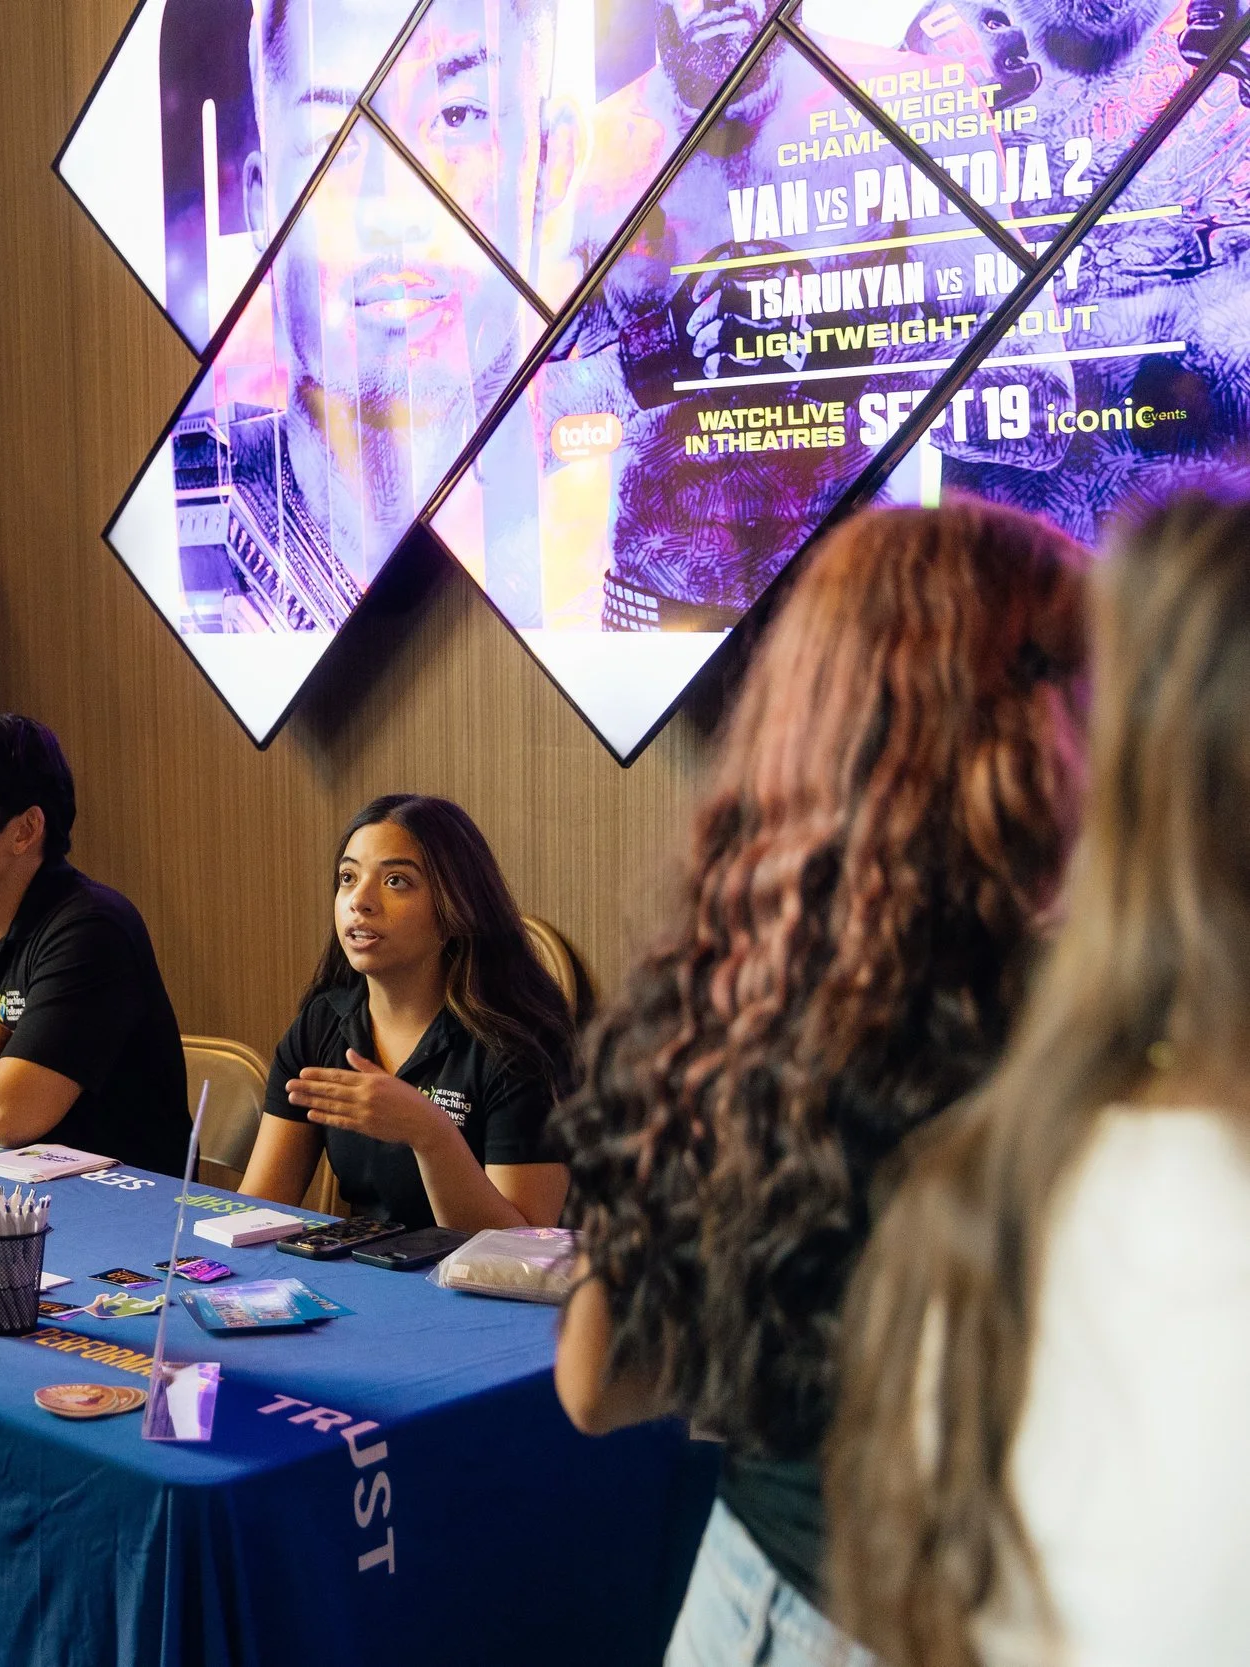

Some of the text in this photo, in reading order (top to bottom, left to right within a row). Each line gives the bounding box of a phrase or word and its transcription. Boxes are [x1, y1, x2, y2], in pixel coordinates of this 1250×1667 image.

[728, 180, 809, 243] VAN
[854, 143, 1052, 227] PANTOJA
[1062, 137, 1093, 197] 2
[746, 261, 925, 321] TSARUKYAN
[974, 241, 1083, 297] RUY
[735, 305, 1099, 361] LIGHTWEIGHT OUT
[559, 417, 613, 447] total
[698, 401, 845, 431] WATCH LIVE
[981, 384, 1031, 441] 19
[1047, 397, 1155, 434] iconic
[685, 426, 846, 455] IN THEATRES
[433, 1094, 472, 1113] Teaching
[257, 1394, 396, 1575] TRUST
